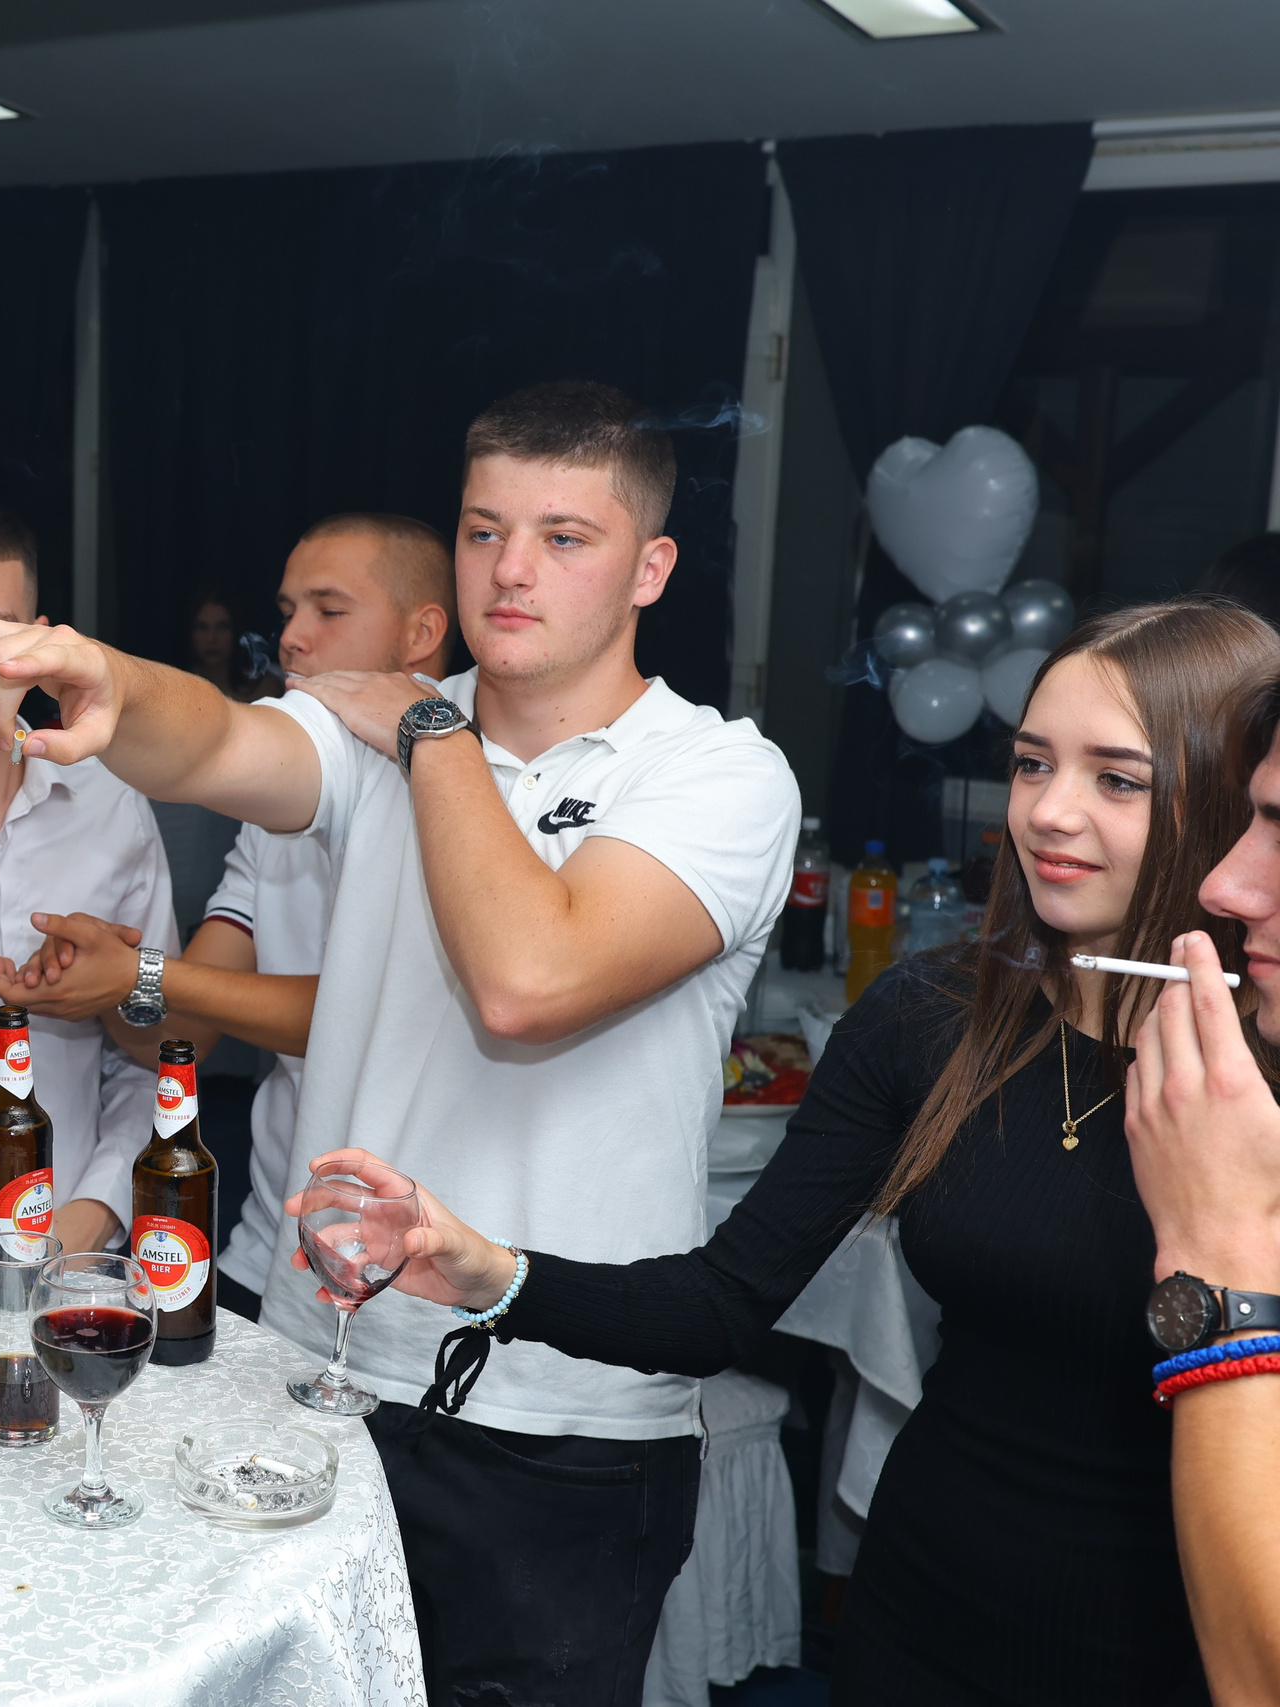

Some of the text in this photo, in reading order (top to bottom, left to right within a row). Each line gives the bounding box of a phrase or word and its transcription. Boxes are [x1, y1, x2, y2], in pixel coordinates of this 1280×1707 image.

[552, 797, 596, 822] NIKE
[9, 1050, 30, 1059] AMSTEL
[158, 1086, 180, 1096] AMSTEL
[21, 1200, 52, 1217] AMSTEL
[31, 1214, 47, 1226] BIER
[142, 1248, 183, 1263] AMSTEL
[151, 1264, 171, 1274] BIER
[169, 1286, 192, 1302] PILSNER
